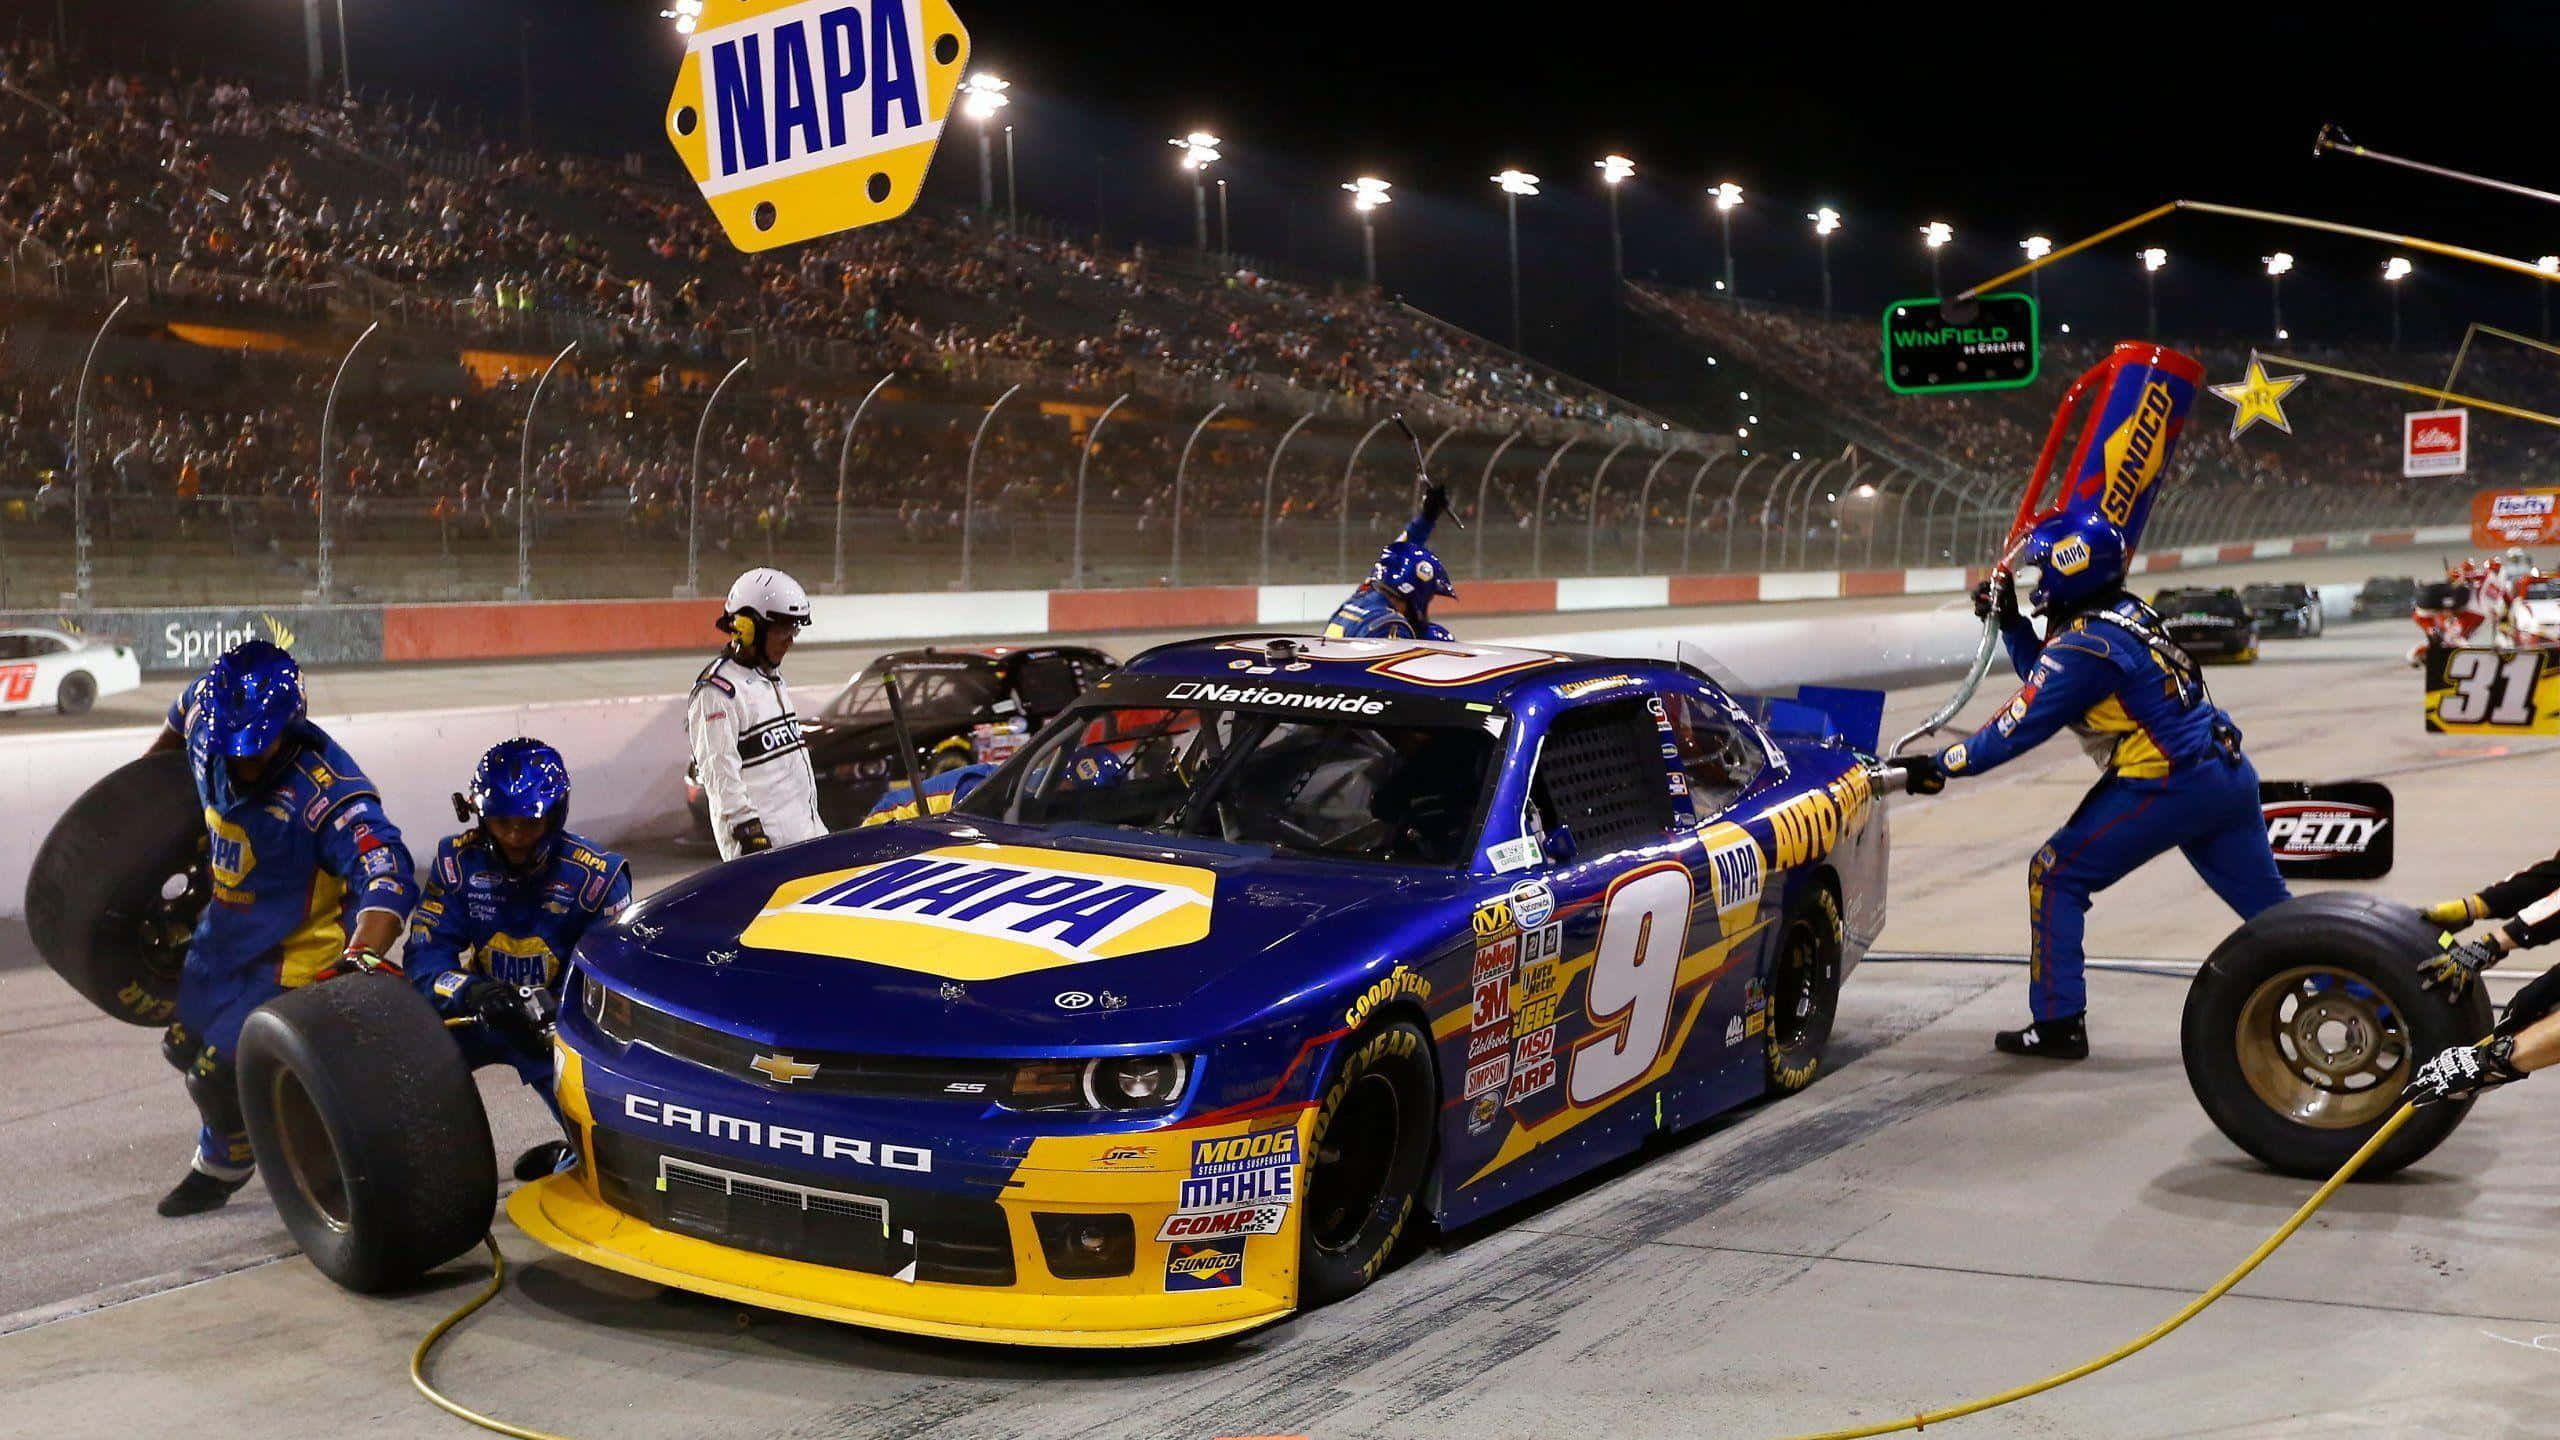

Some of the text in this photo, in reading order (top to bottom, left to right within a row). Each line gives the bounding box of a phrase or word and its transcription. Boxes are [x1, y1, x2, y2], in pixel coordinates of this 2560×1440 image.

[712, 0, 922, 176] NAPA
[2105, 391, 2170, 523] SUNOCO
[2055, 543, 2087, 568] NAPA
[1193, 683, 1384, 715] Nationwide
[2438, 650, 2541, 724] 31
[1769, 792, 1838, 873] AUTO
[2267, 816, 2389, 848] PETTY
[572, 848, 607, 873] NAPA
[1714, 843, 1760, 908] NAPA
[800, 858, 1168, 949] NAPA
[491, 950, 546, 987] NAPA
[1568, 862, 1694, 1109] 9
[1345, 965, 1432, 1030] GOODYEAR
[1473, 976, 1510, 1027] 3M
[1512, 995, 1558, 1038] JEGS
[1469, 1026, 1511, 1060] Edelbrock
[1517, 1027, 1554, 1064] MSD
[943, 1082, 987, 1093] SS
[1468, 1059, 1507, 1093] SIMPSON
[1507, 1061, 1555, 1101] ARP
[624, 1093, 932, 1173] CAMARO
[1195, 1129, 1295, 1165] MOOG
[1198, 1162, 1236, 1176] STEERING
[1246, 1153, 1293, 1170] SUSPENSION
[1181, 1167, 1292, 1209] MAHLE
[1166, 1210, 1256, 1236] COMP
[1172, 1254, 1240, 1272] SUNOCO
